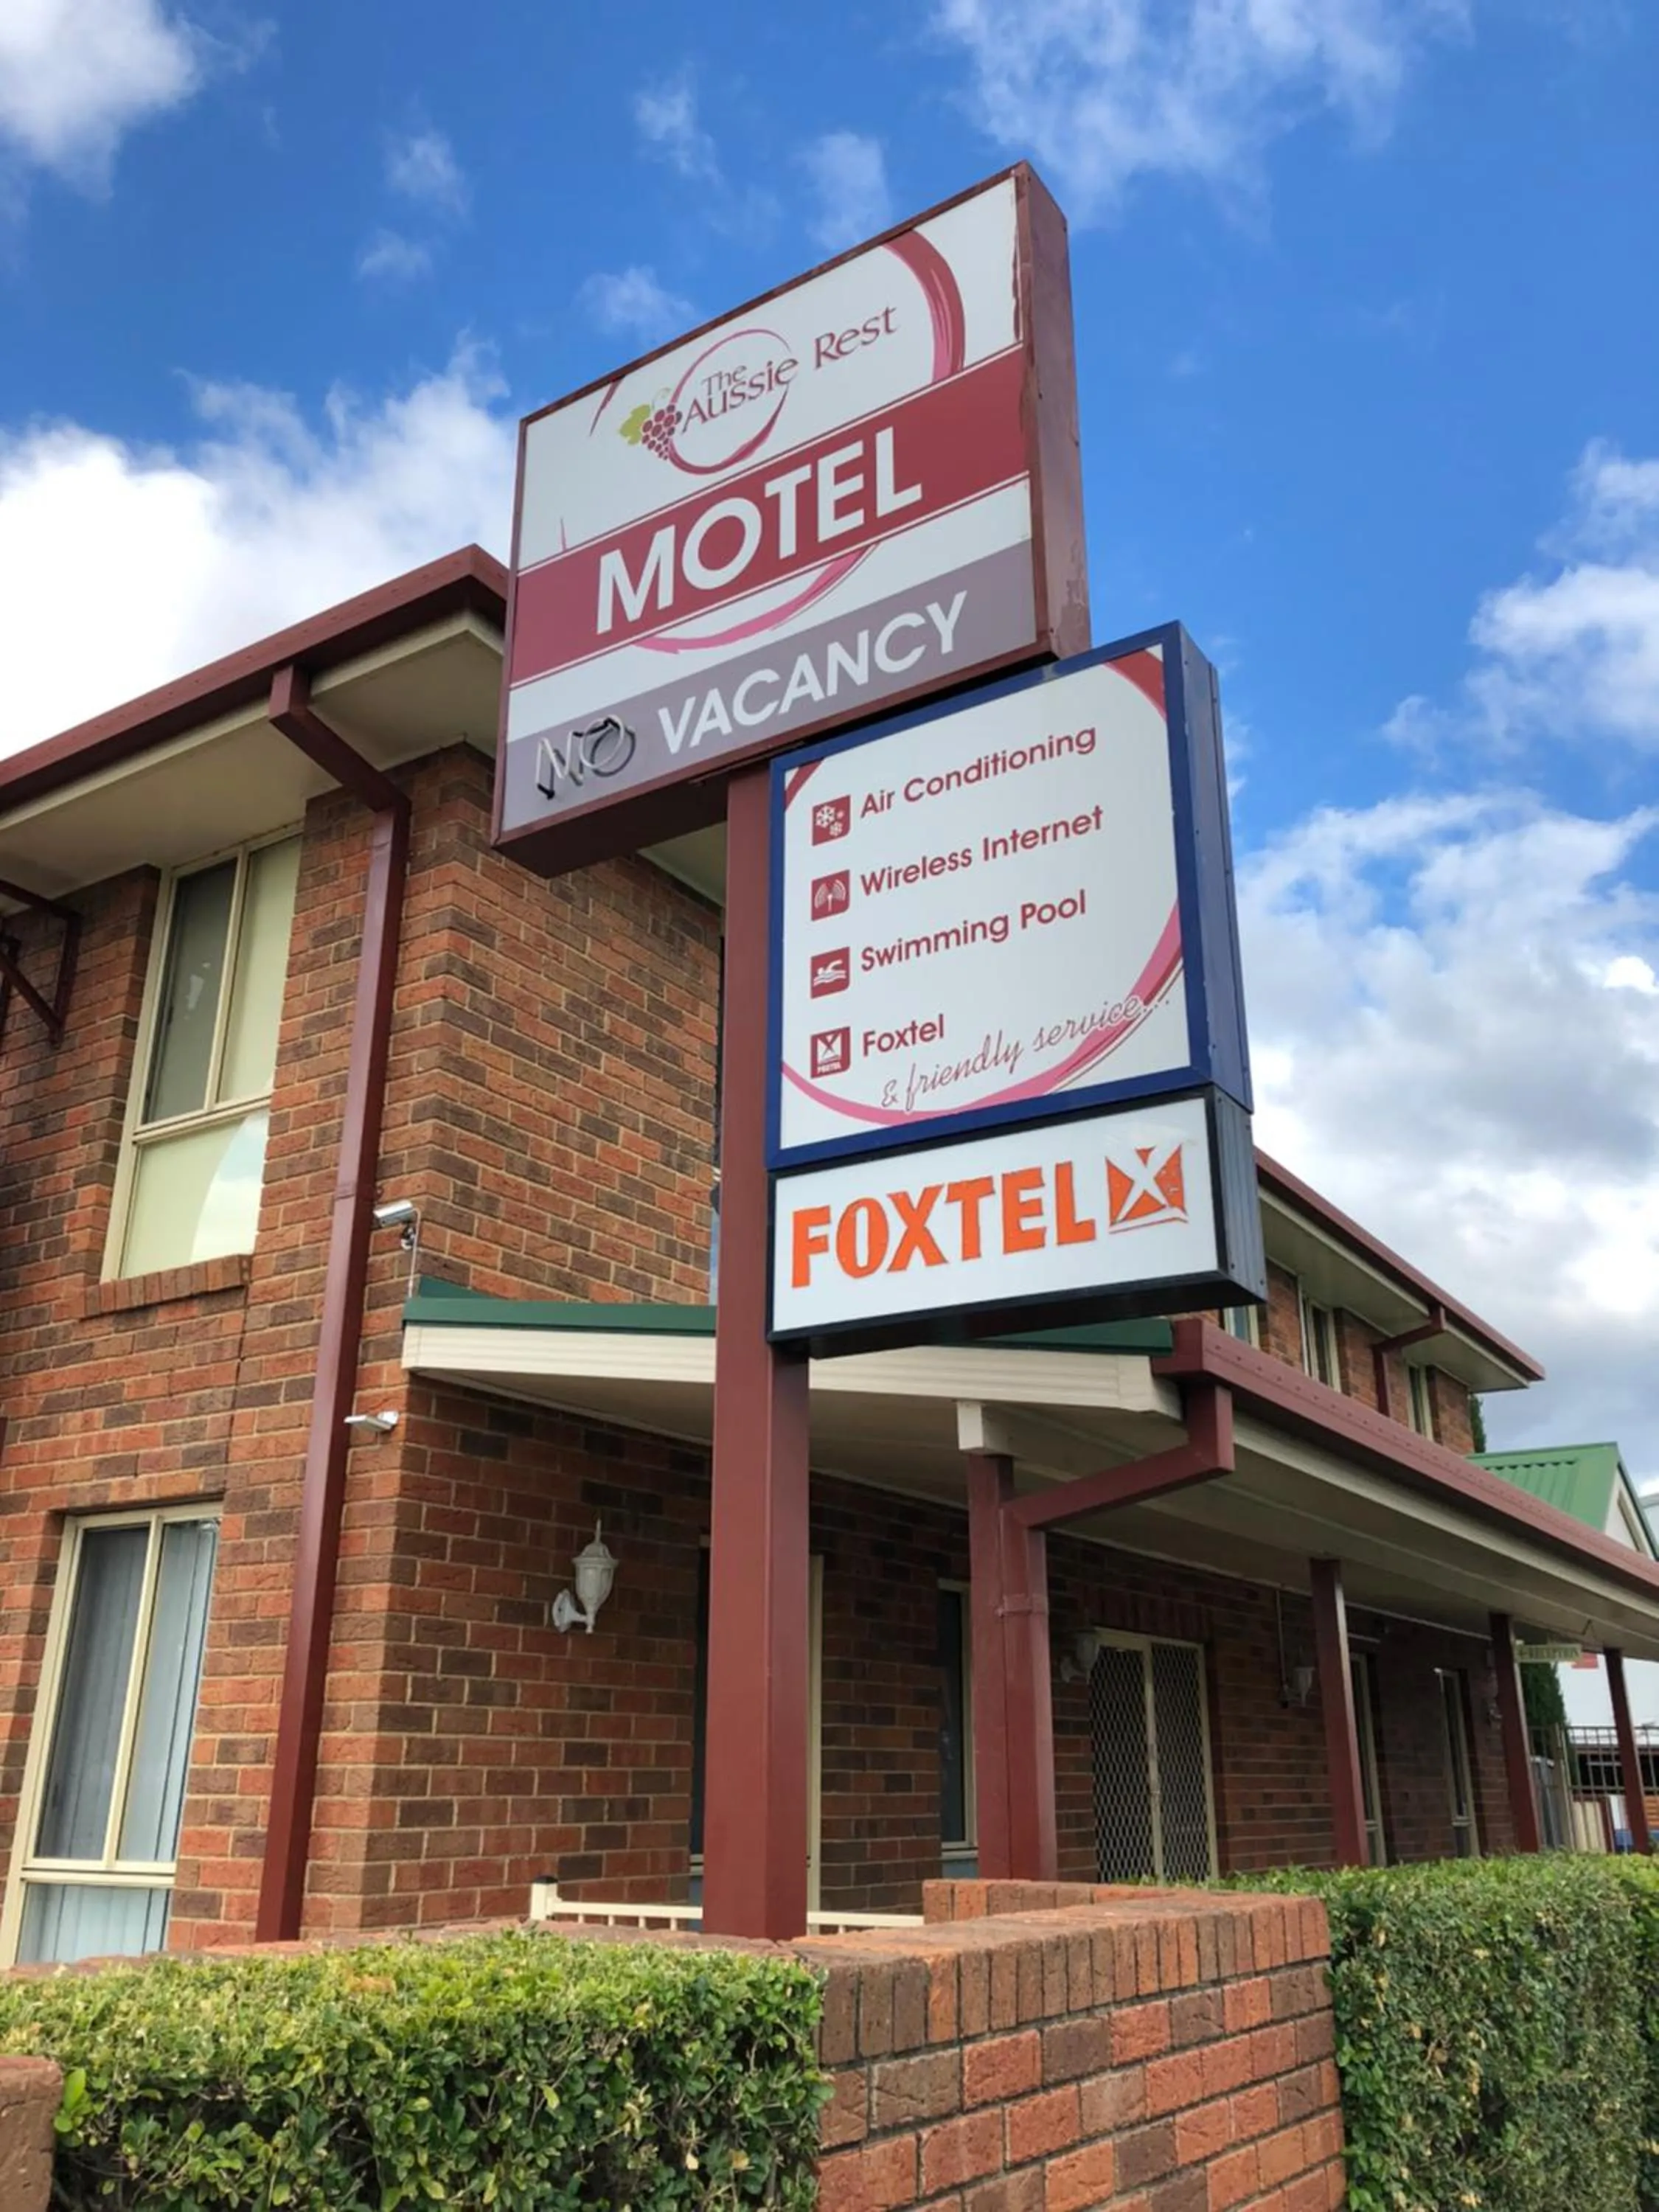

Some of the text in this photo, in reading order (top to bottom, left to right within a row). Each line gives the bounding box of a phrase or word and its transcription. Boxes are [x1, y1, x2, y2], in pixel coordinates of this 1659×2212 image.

[681, 306, 898, 435] Aussie Rest
[703, 365, 748, 397] The
[597, 426, 922, 634] MOTEL
[534, 591, 968, 800] NO VACANCY
[860, 728, 1097, 818] Air Conditioning
[860, 805, 1103, 896] Wireless Internet
[861, 889, 1087, 972] Swimming Pool
[862, 1014, 945, 1057] Foxtel
[881, 1079, 898, 1108] &
[905, 1030, 1025, 1113] friendly
[792, 1160, 1096, 1288] FOXTEL
